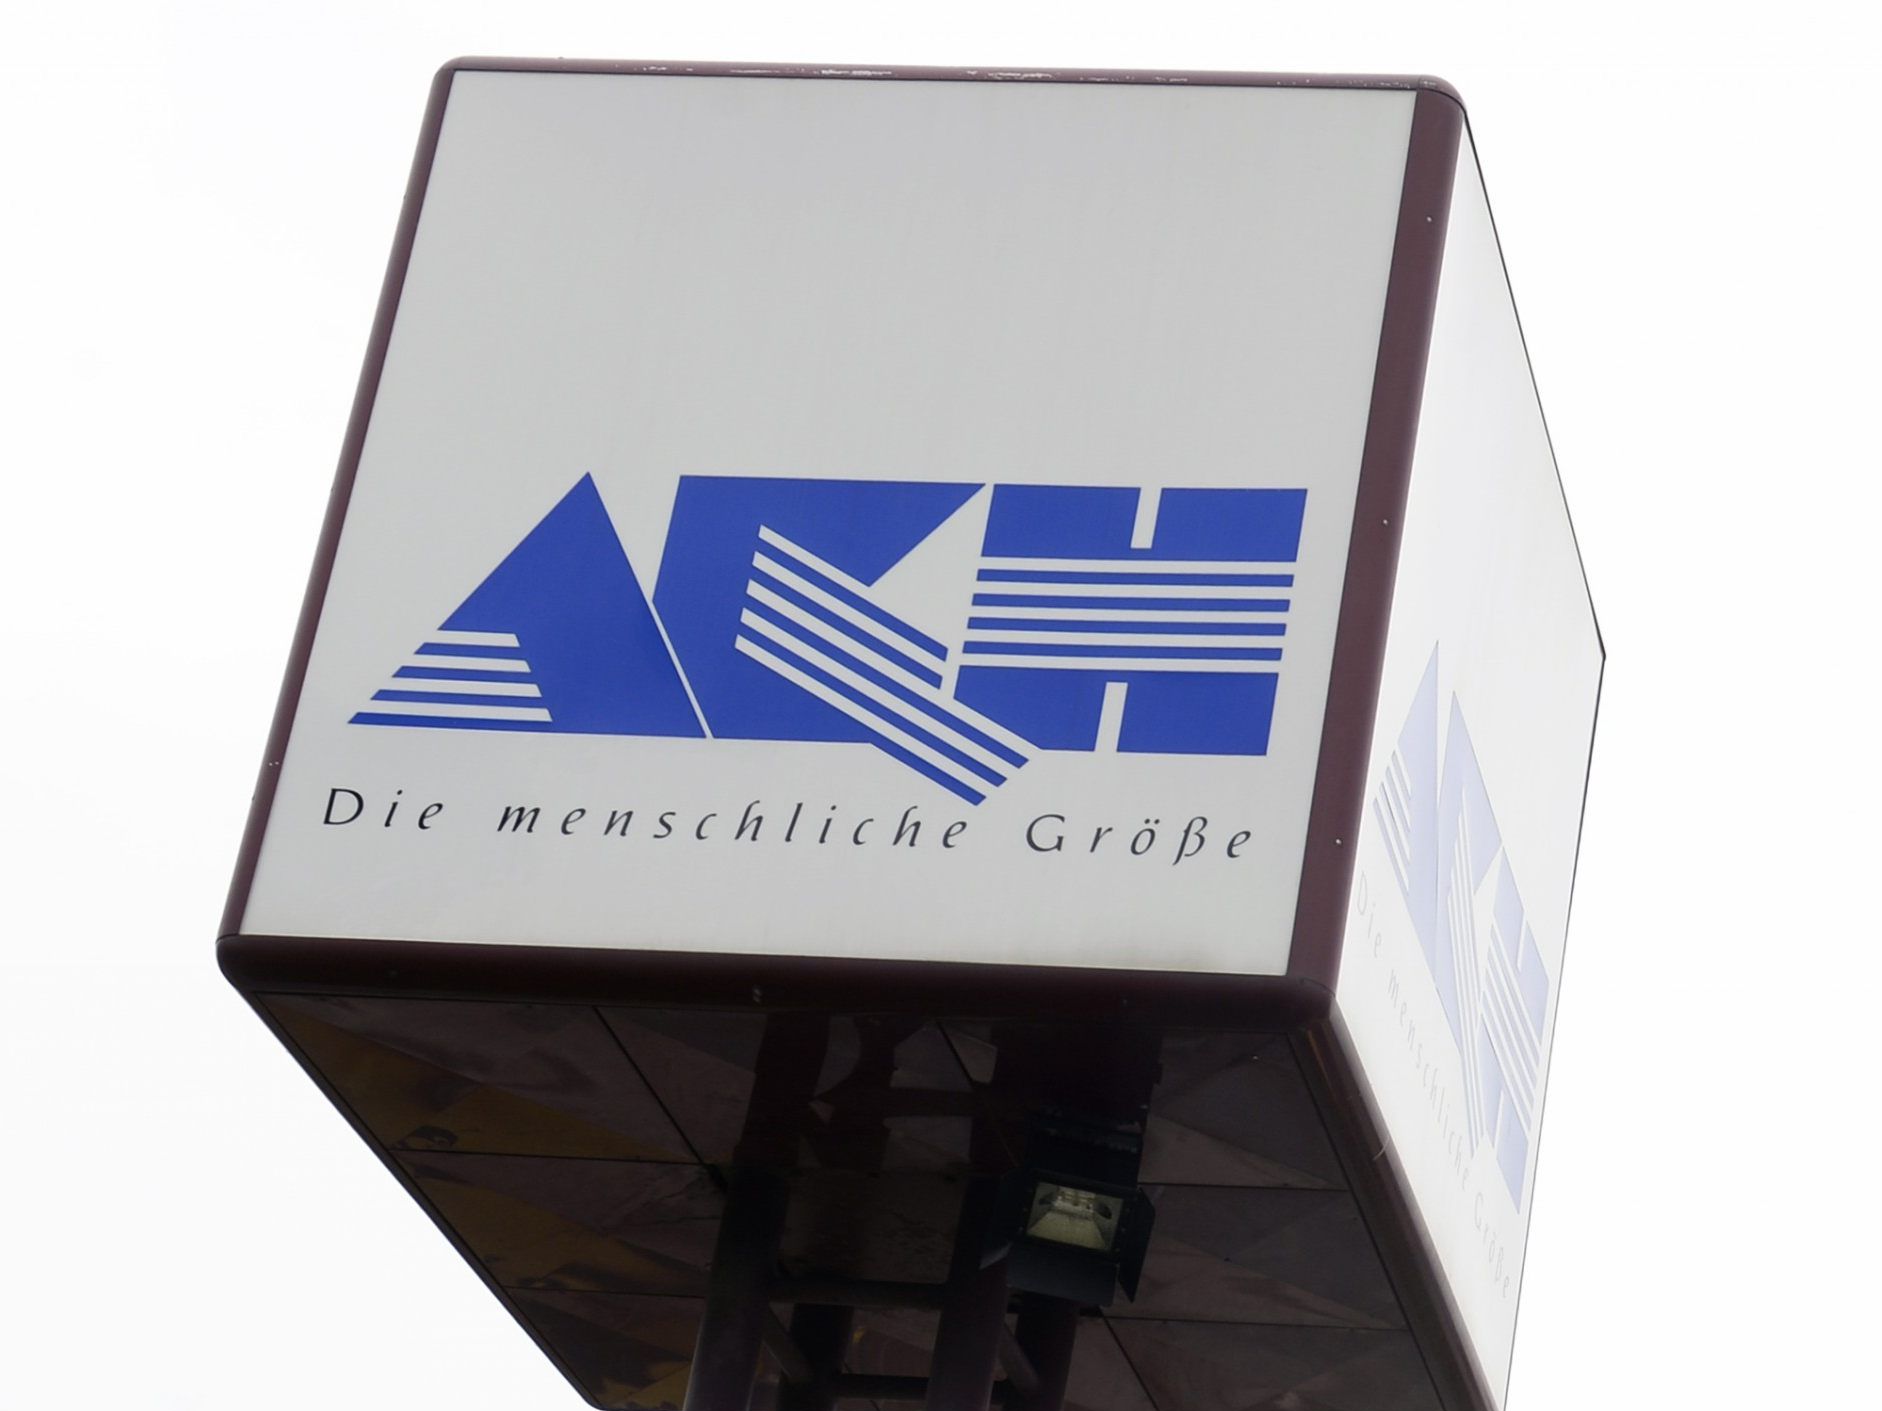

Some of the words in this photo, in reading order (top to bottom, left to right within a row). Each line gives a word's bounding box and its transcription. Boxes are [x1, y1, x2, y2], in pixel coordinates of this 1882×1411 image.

[347, 471, 1308, 807] AKH
[323, 787, 445, 831] Die
[496, 797, 969, 851] menschliche
[1026, 812, 1253, 867] Größe
[1356, 871, 1383, 960] Die
[1387, 967, 1470, 1192] menschliche
[1474, 1191, 1510, 1299] Größe
